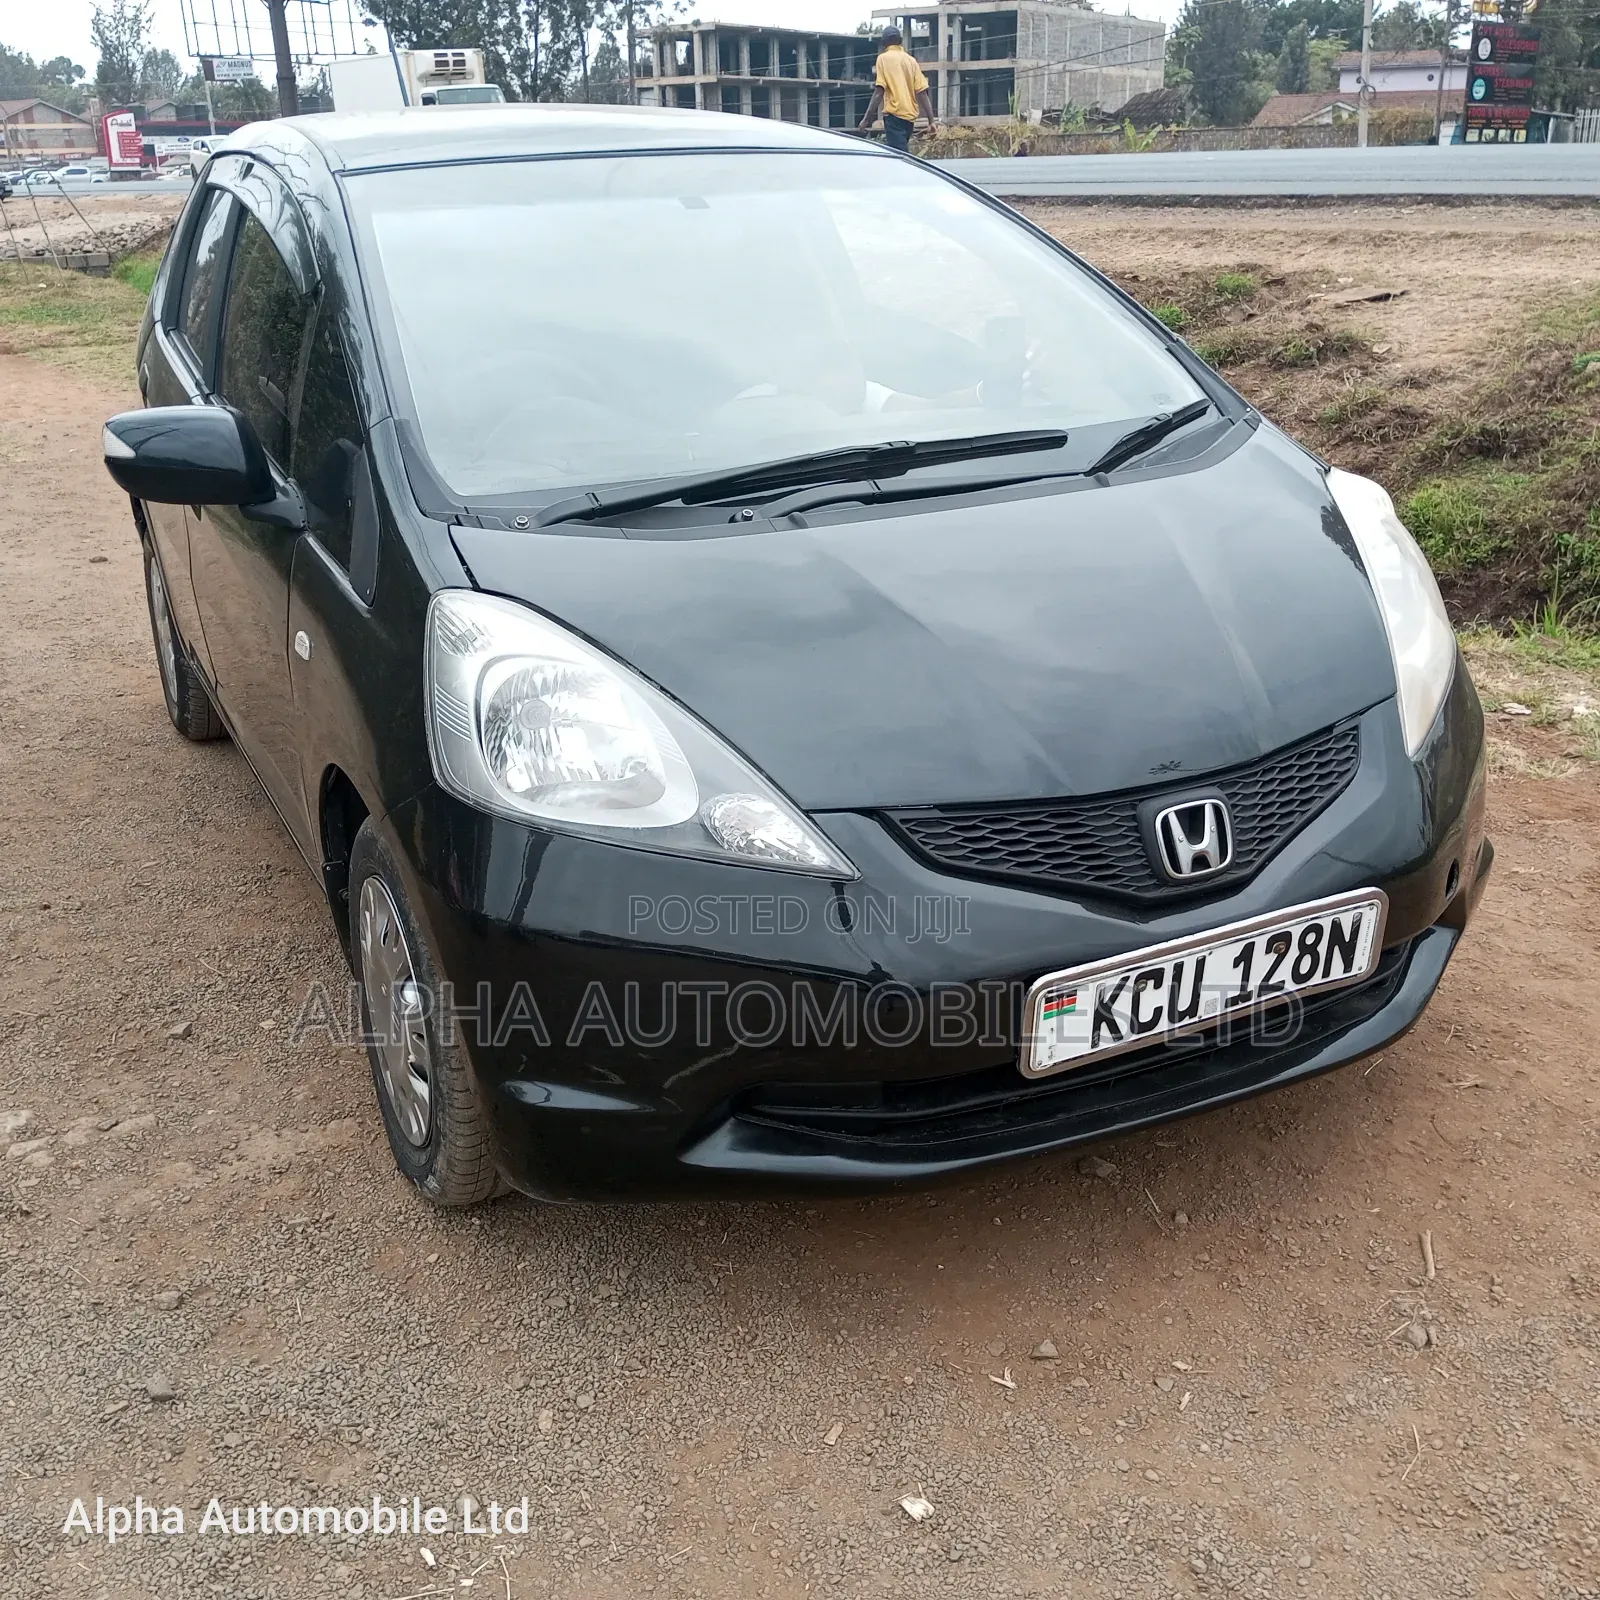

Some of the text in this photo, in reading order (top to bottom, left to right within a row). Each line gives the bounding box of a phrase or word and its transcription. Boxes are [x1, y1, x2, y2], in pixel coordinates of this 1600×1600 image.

[1495, 26, 1514, 37] AUTO
[1496, 40, 1538, 51] ACCESSORIES
[1468, 107, 1486, 117] FOOD
[1494, 107, 1531, 118] BEVERAGES
[1090, 955, 1206, 1050] KCU
[1224, 911, 1363, 1009] 128N
